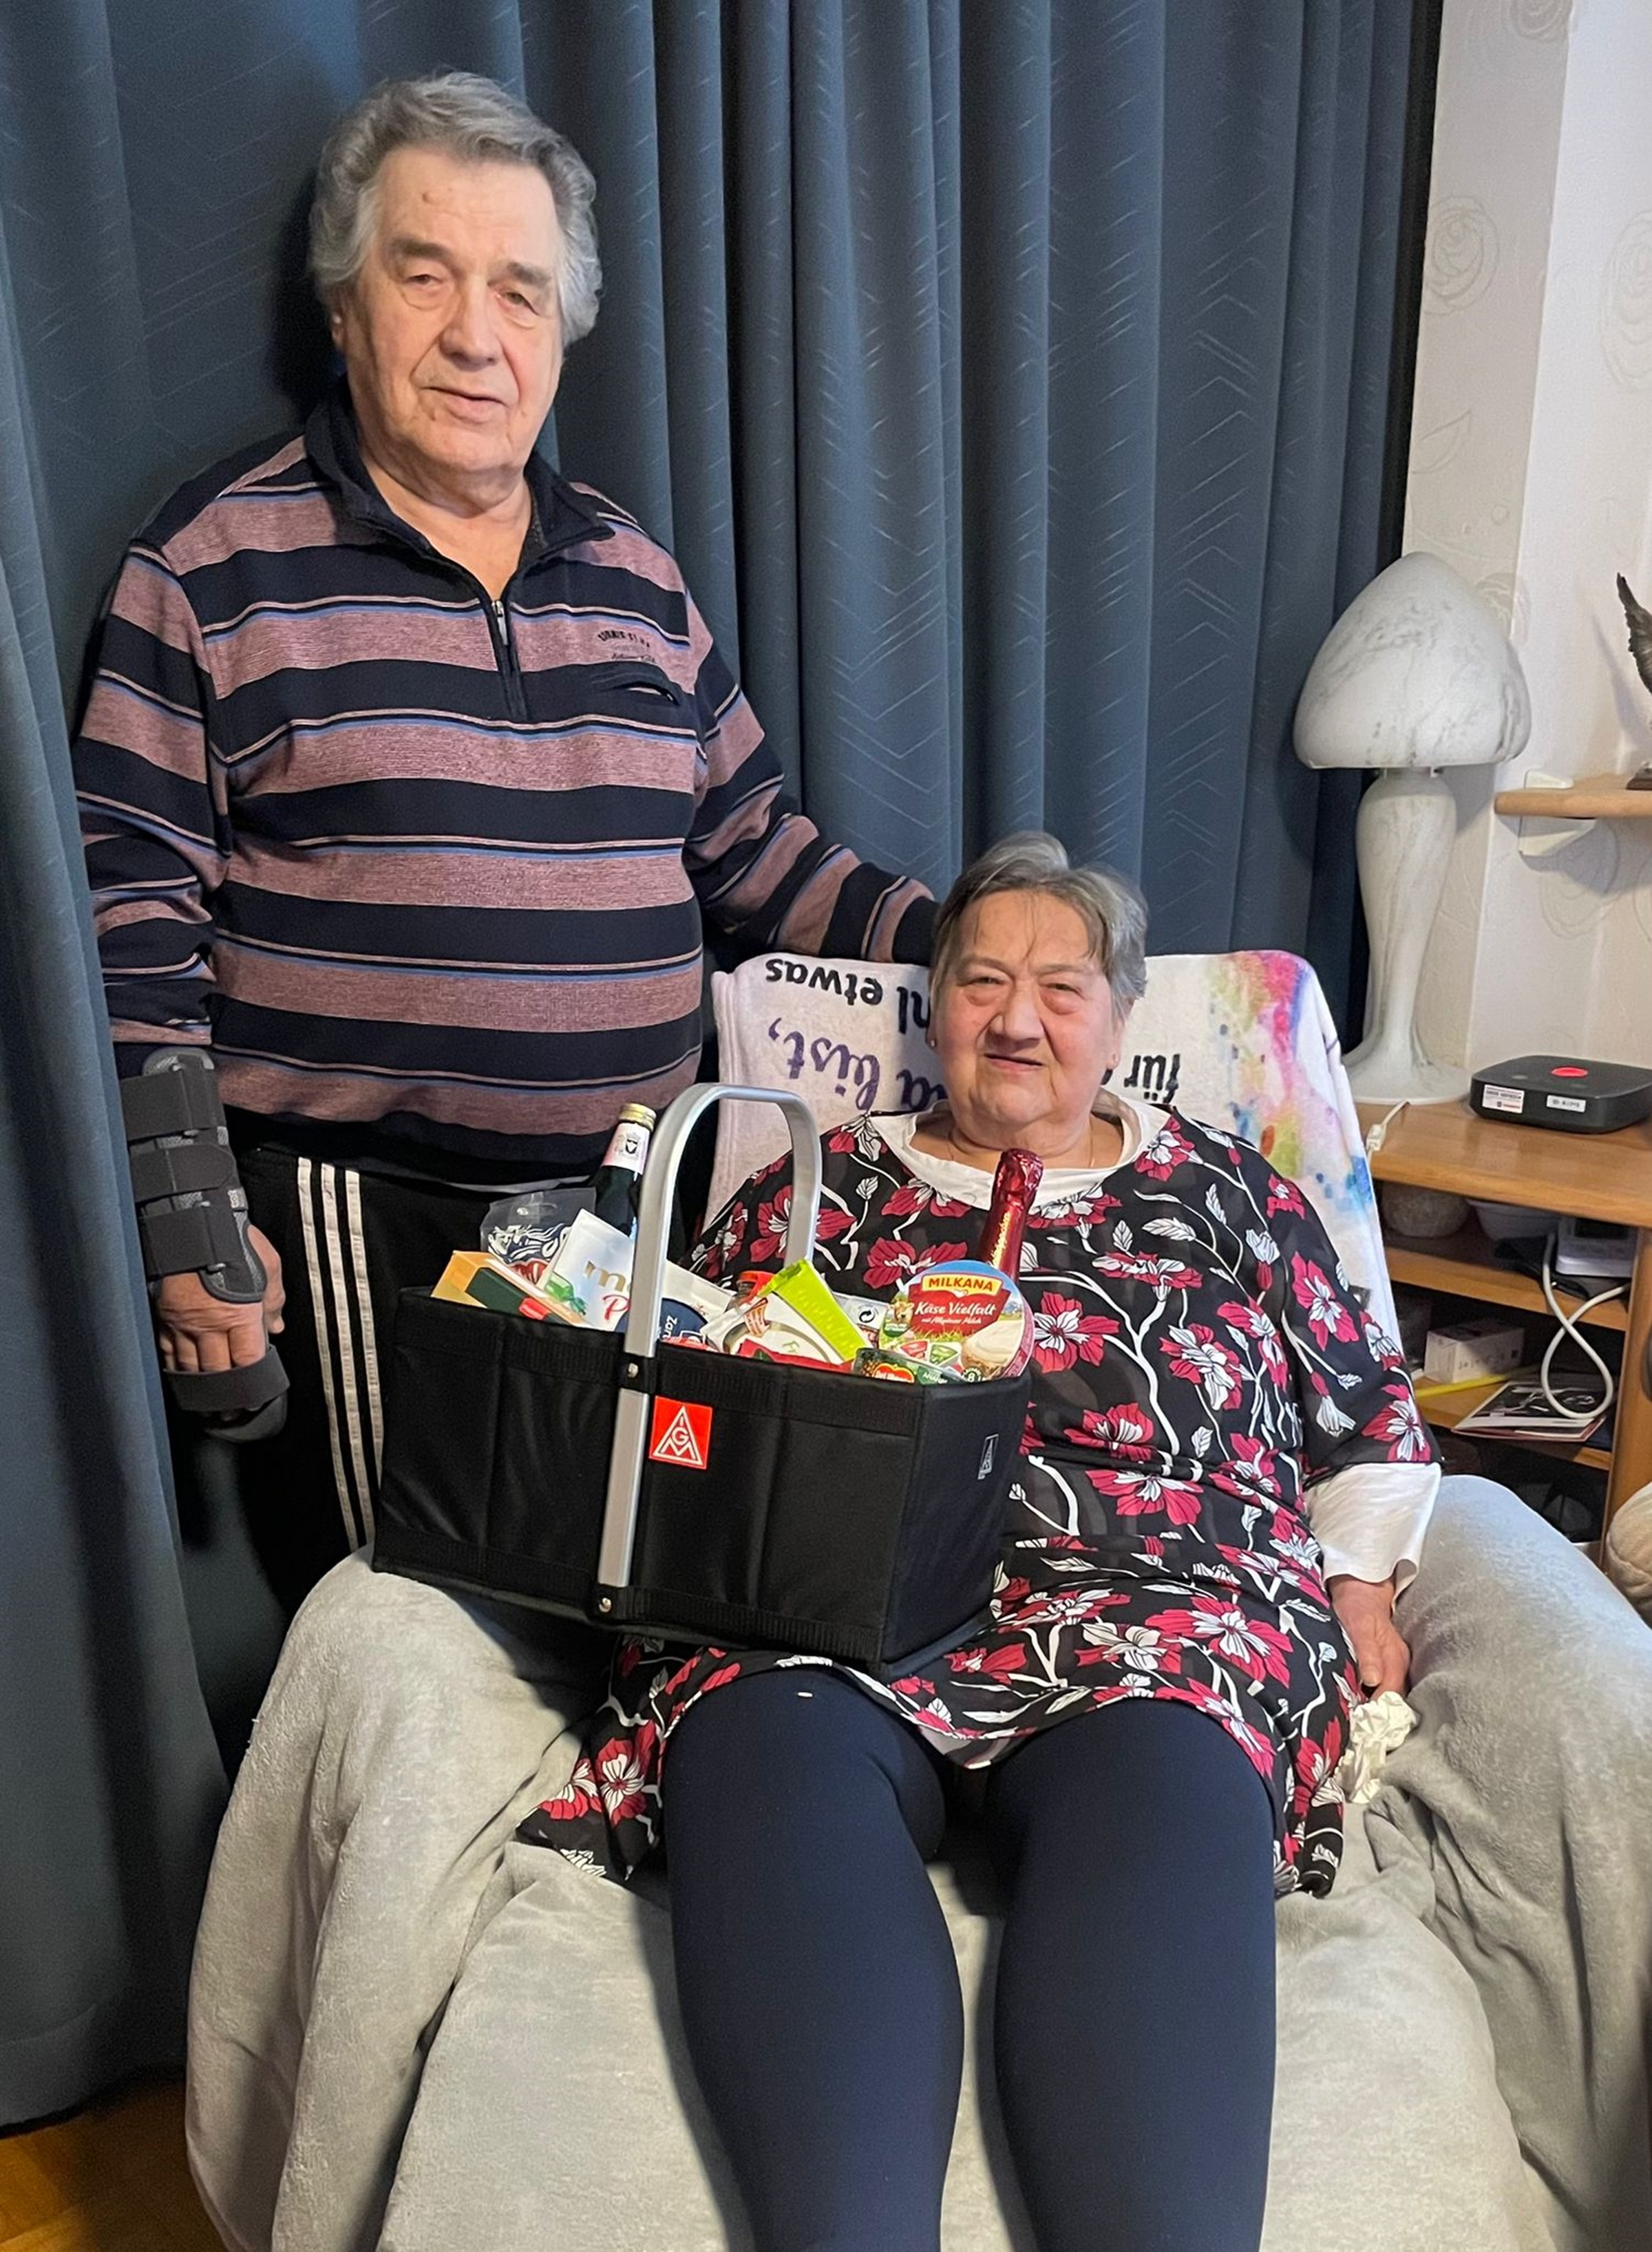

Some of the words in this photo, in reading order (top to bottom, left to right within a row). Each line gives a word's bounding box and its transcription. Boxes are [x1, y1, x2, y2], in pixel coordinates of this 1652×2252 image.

[765, 958, 883, 1006] etwas
[1123, 1053, 1180, 1104] für
[929, 1277, 993, 1292] MILKANA
[915, 1302, 946, 1315] Käse
[949, 1302, 997, 1318] Vielfalt
